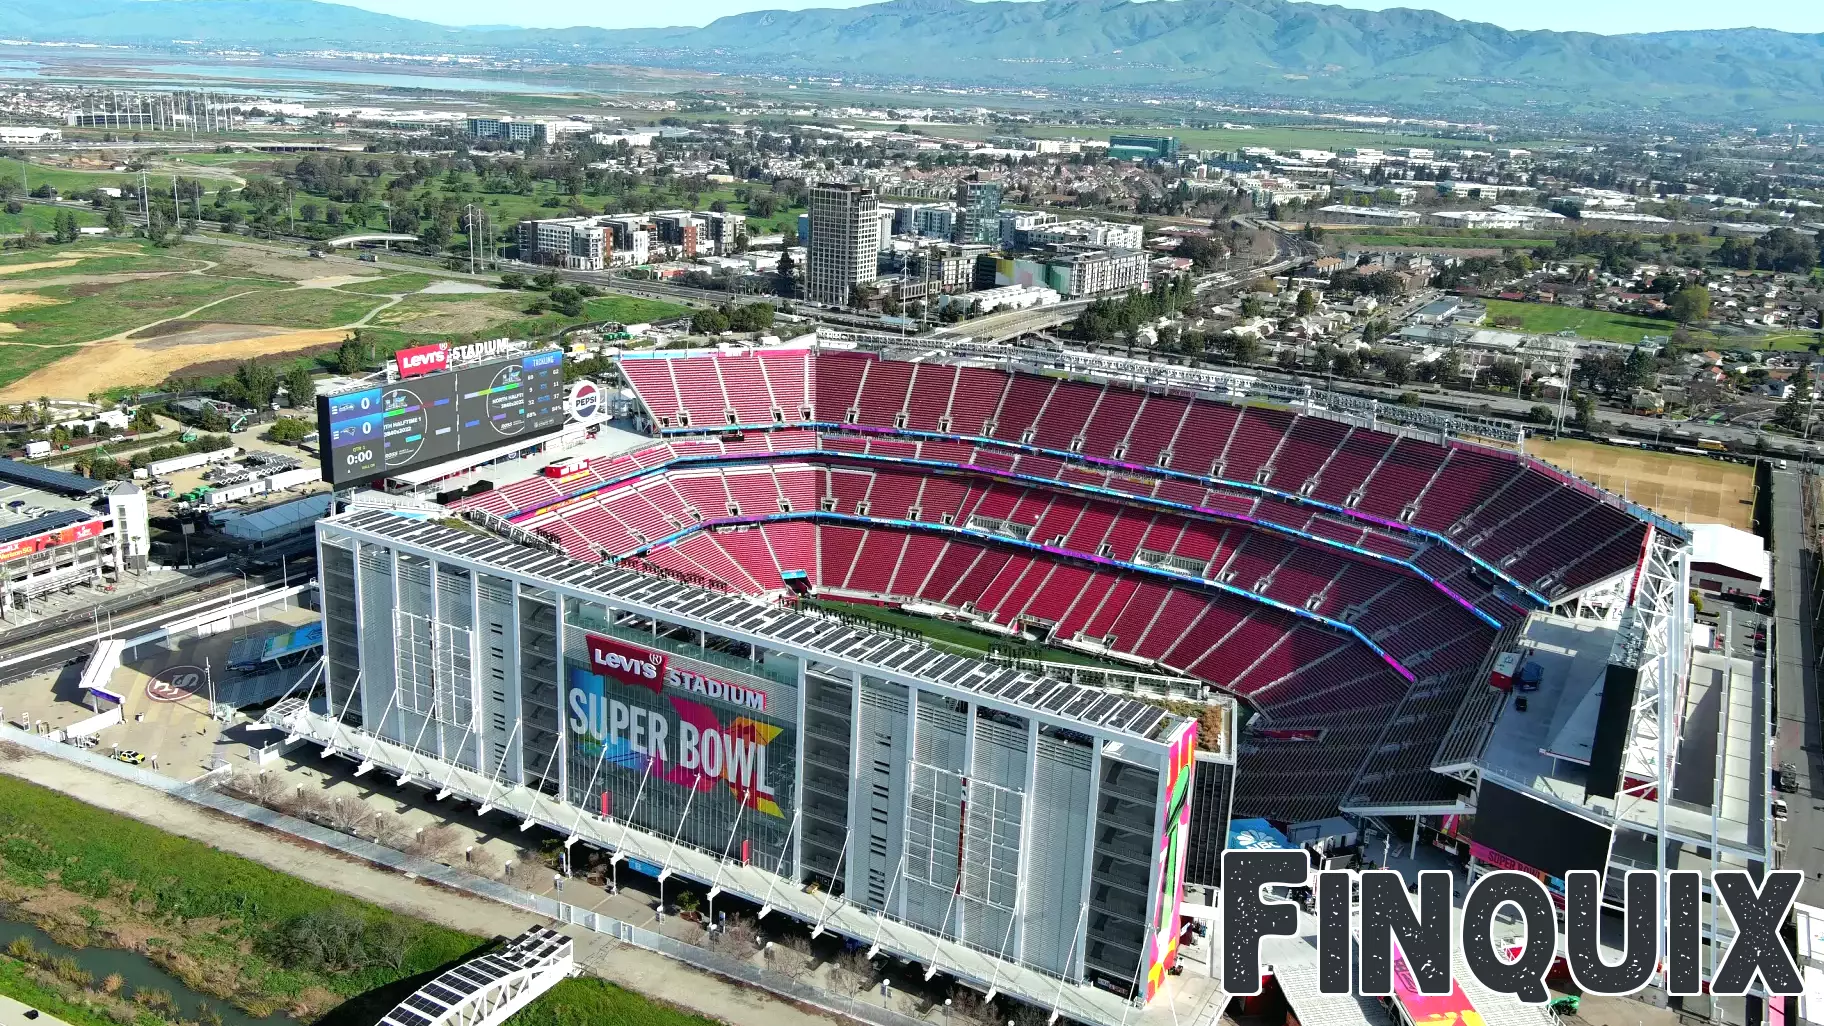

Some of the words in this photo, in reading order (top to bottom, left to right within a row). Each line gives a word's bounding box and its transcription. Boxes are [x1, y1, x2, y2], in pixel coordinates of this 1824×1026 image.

[453, 338, 509, 360] STADIUM
[361, 397, 370, 410] 0
[575, 396, 597, 407] PEPSI
[362, 421, 371, 434] 0
[346, 450, 373, 465] 0:00
[668, 670, 766, 711] STADIUM
[569, 687, 668, 761] SUPER
[680, 720, 775, 795] BOWL
[1488, 851, 1516, 870] SUPER
